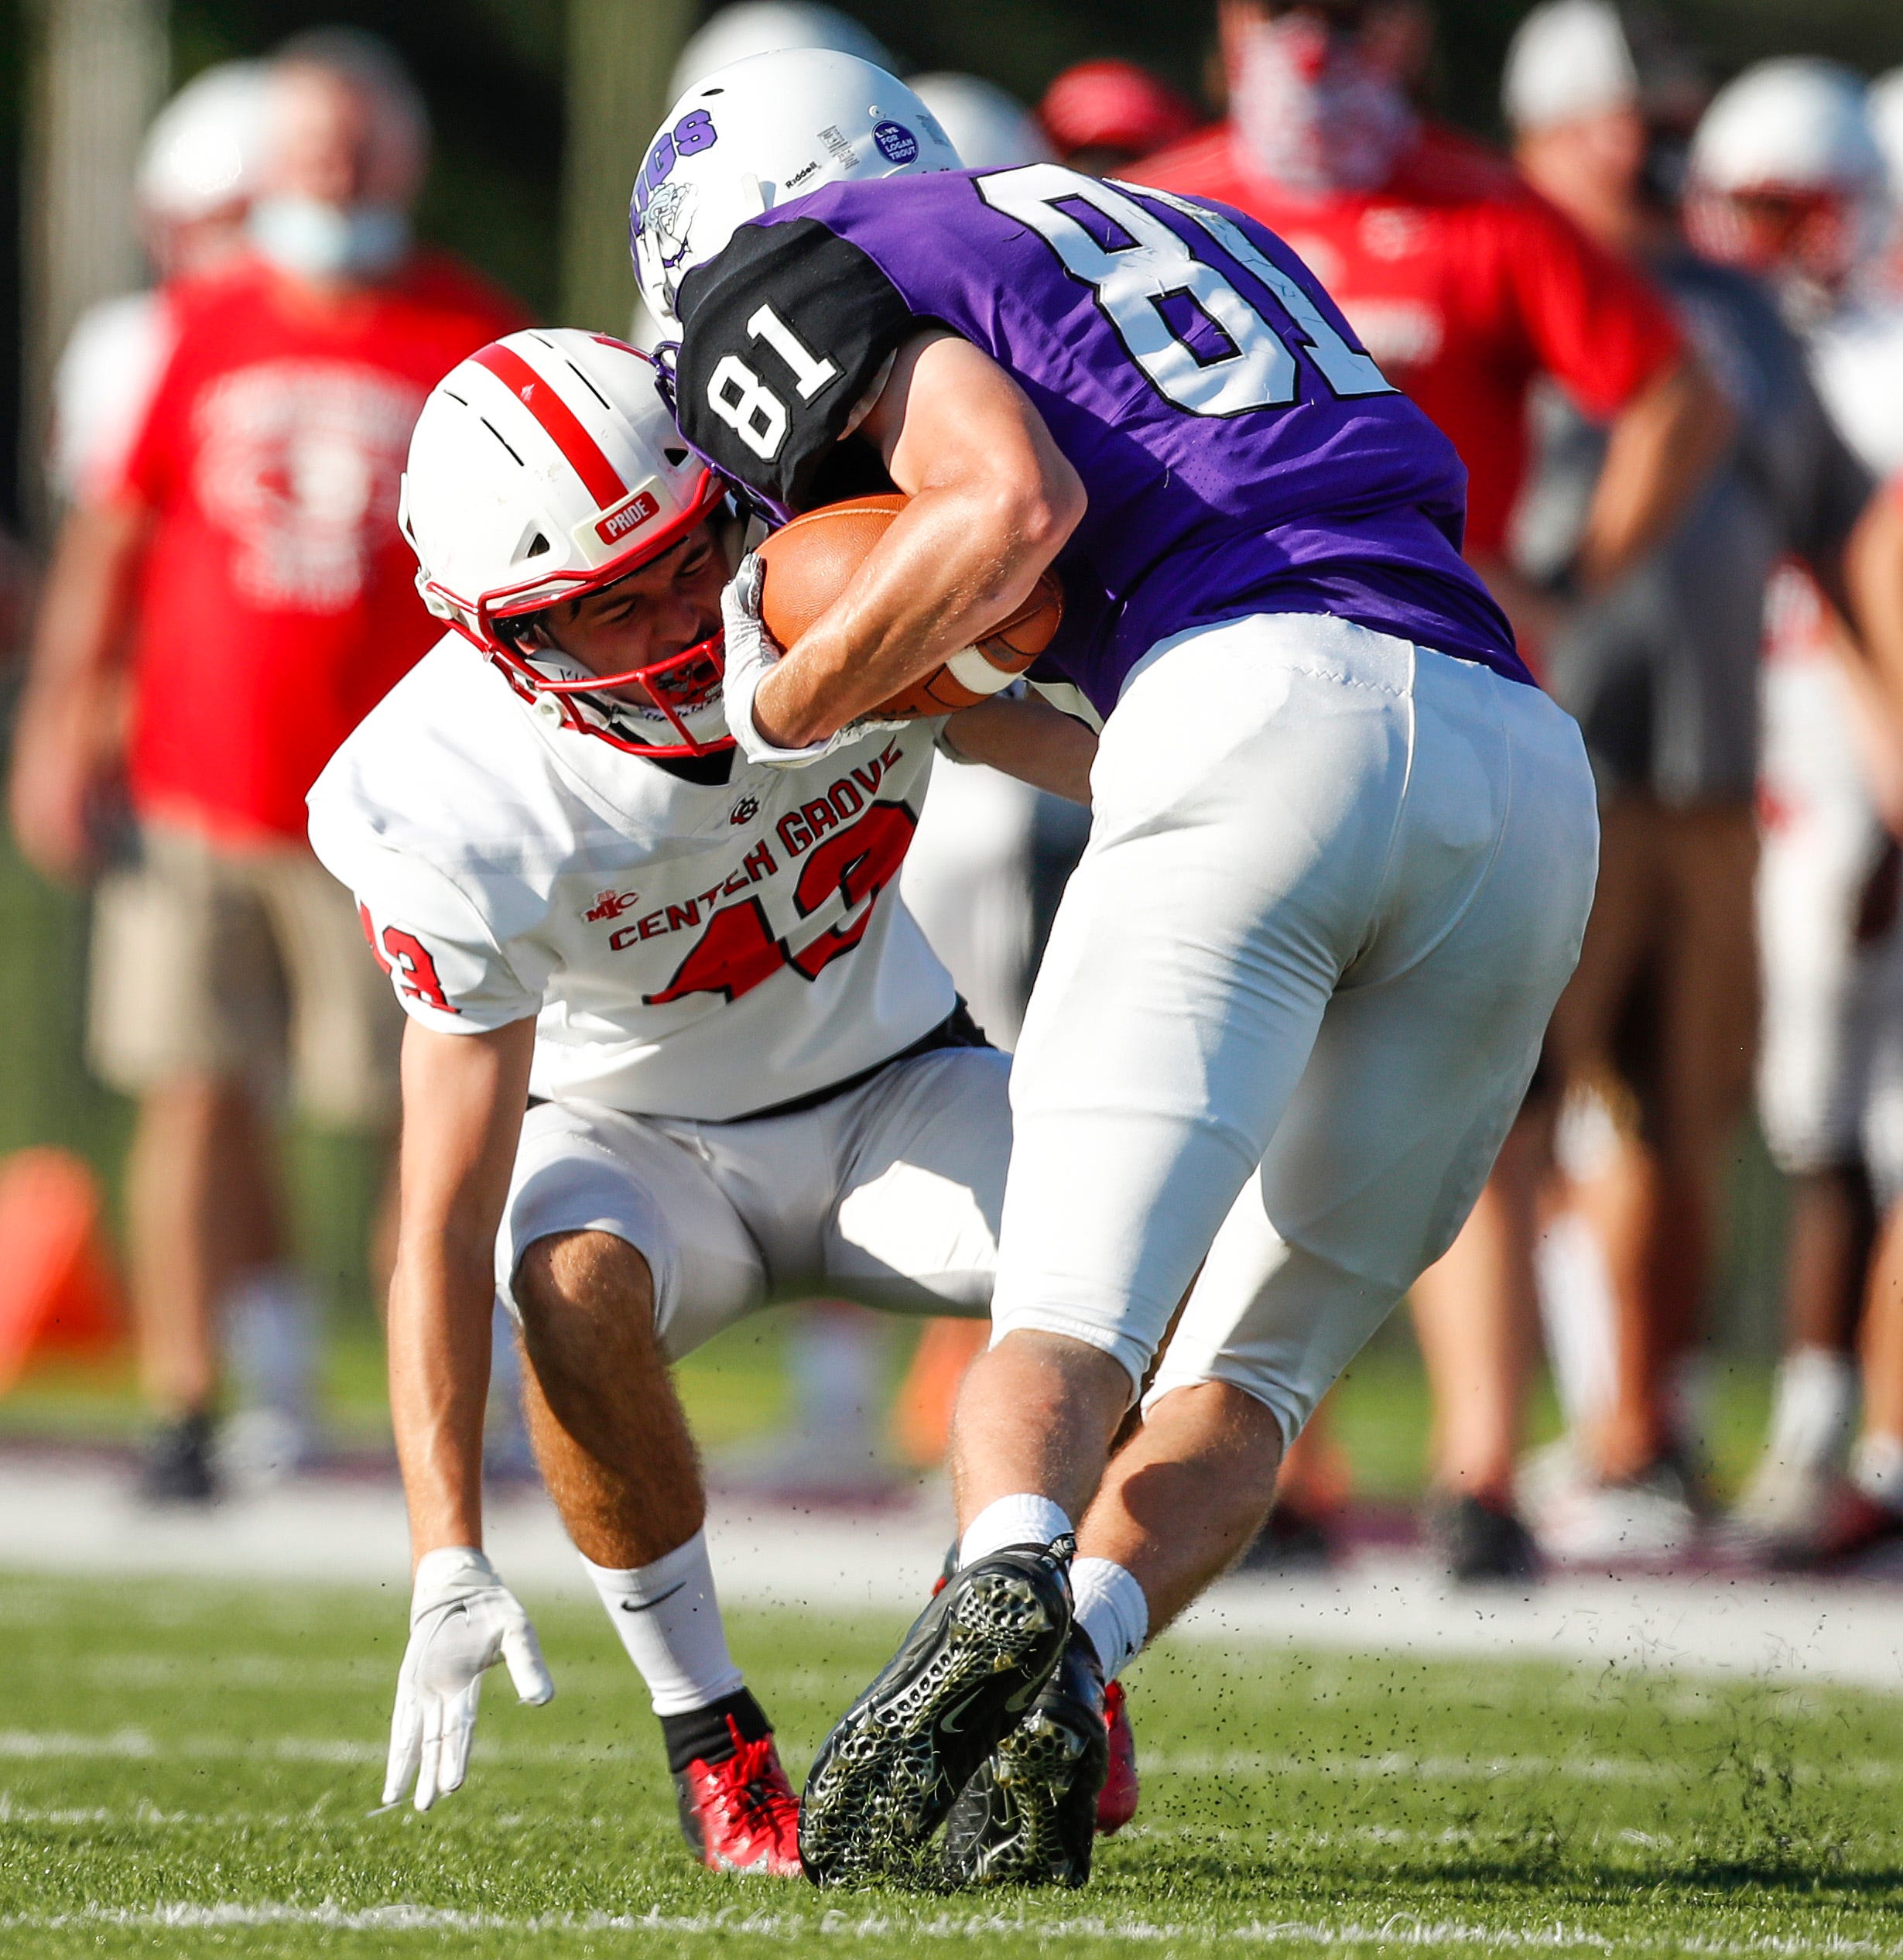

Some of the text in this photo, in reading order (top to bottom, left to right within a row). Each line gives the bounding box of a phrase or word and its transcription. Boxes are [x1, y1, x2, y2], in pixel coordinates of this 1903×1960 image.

[880, 134, 899, 145] FOR
[885, 138, 914, 152] LOGAN
[888, 146, 916, 160] TROUT
[970, 163, 1402, 419] 81
[706, 303, 842, 462] 81
[604, 498, 650, 537] PRIDE
[775, 734, 904, 858] GROVE
[359, 900, 463, 1014] 3
